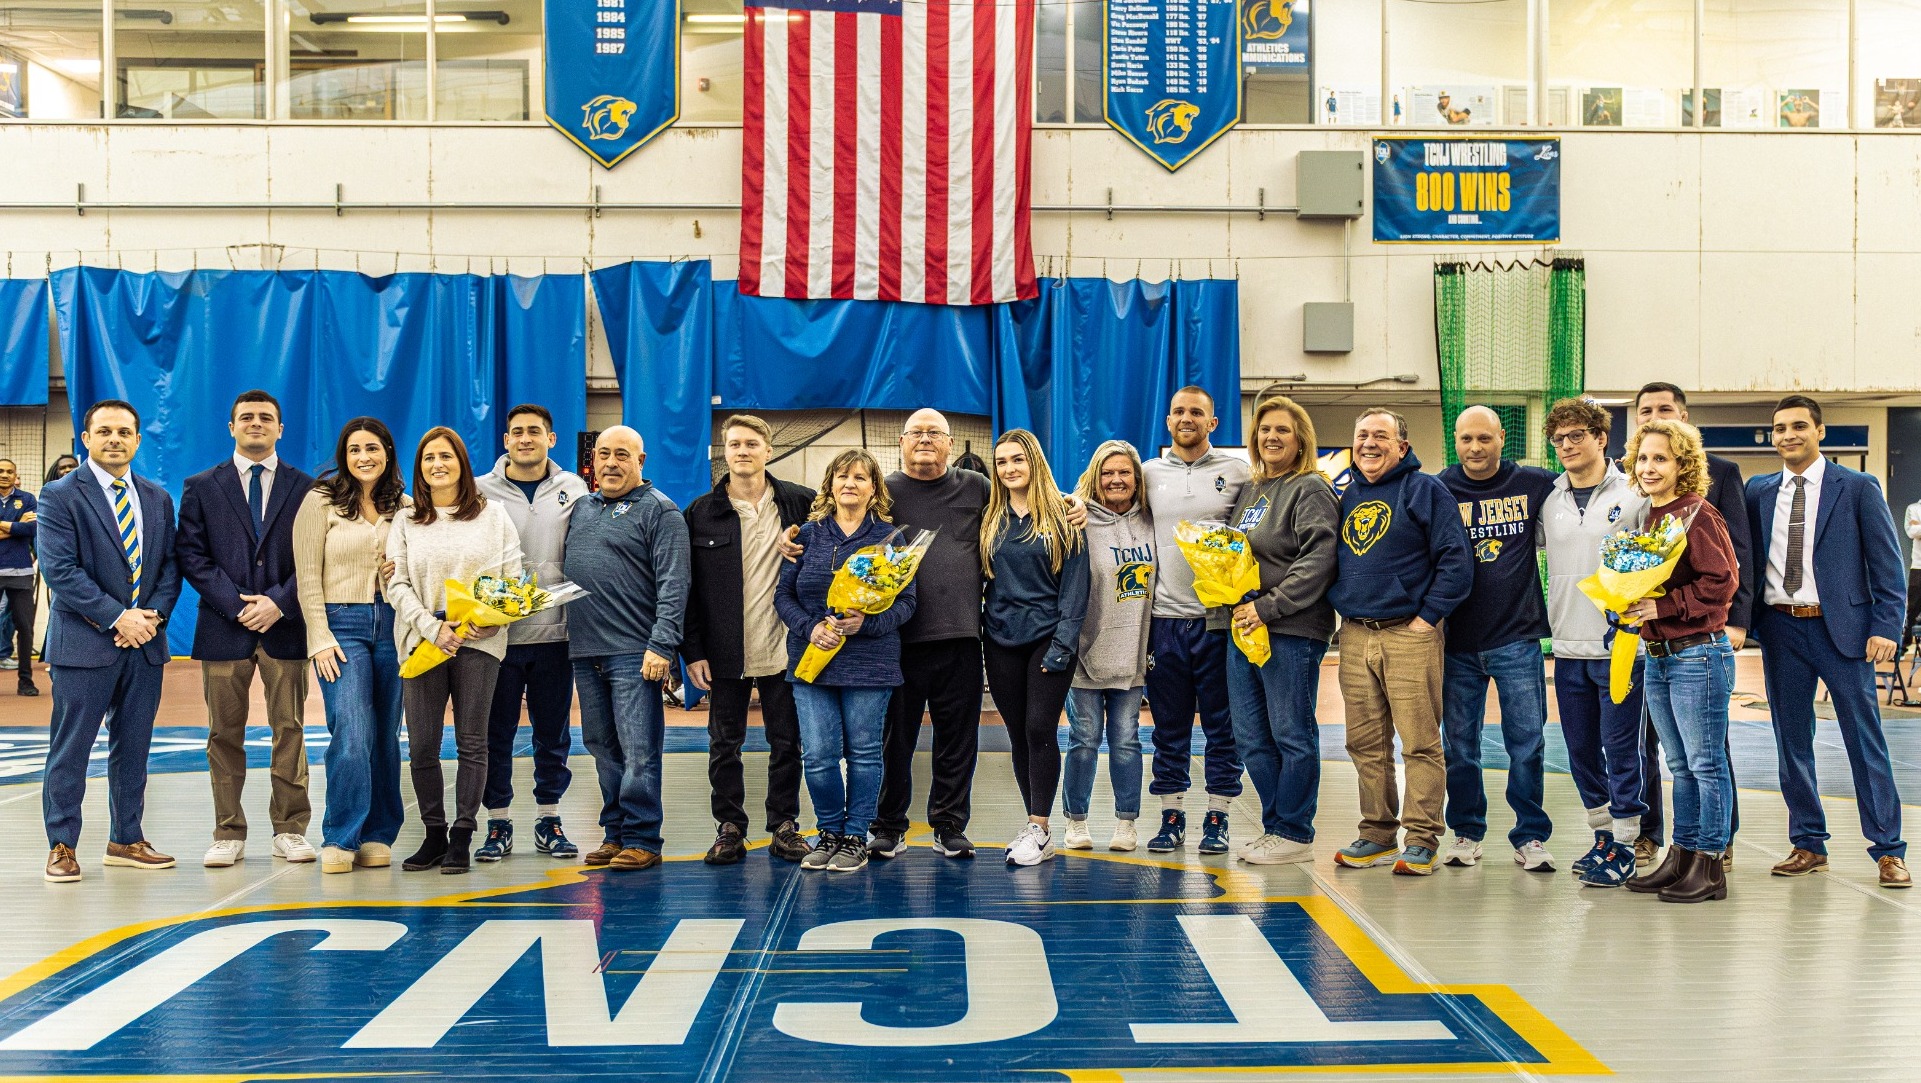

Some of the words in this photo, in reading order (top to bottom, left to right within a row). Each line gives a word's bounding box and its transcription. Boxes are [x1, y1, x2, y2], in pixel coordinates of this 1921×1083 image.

[596, 11, 626, 22] 1984
[596, 28, 625, 39] 1985
[596, 42, 625, 54] 1987
[1246, 42, 1290, 52] ATHLETICS
[1242, 52, 1306, 63] MMUNICATIONS
[1424, 142, 1450, 166] TCNJ
[1451, 142, 1508, 166] WRESTLING
[1416, 172, 1455, 212] 800
[1460, 172, 1511, 212] WINS
[1240, 508, 1267, 524] TCNJ
[1478, 494, 1528, 526] JERSEY
[1469, 522, 1524, 539] ESTLING
[1109, 543, 1152, 566] TCNJ
[0, 915, 1457, 1050] TCNJ
